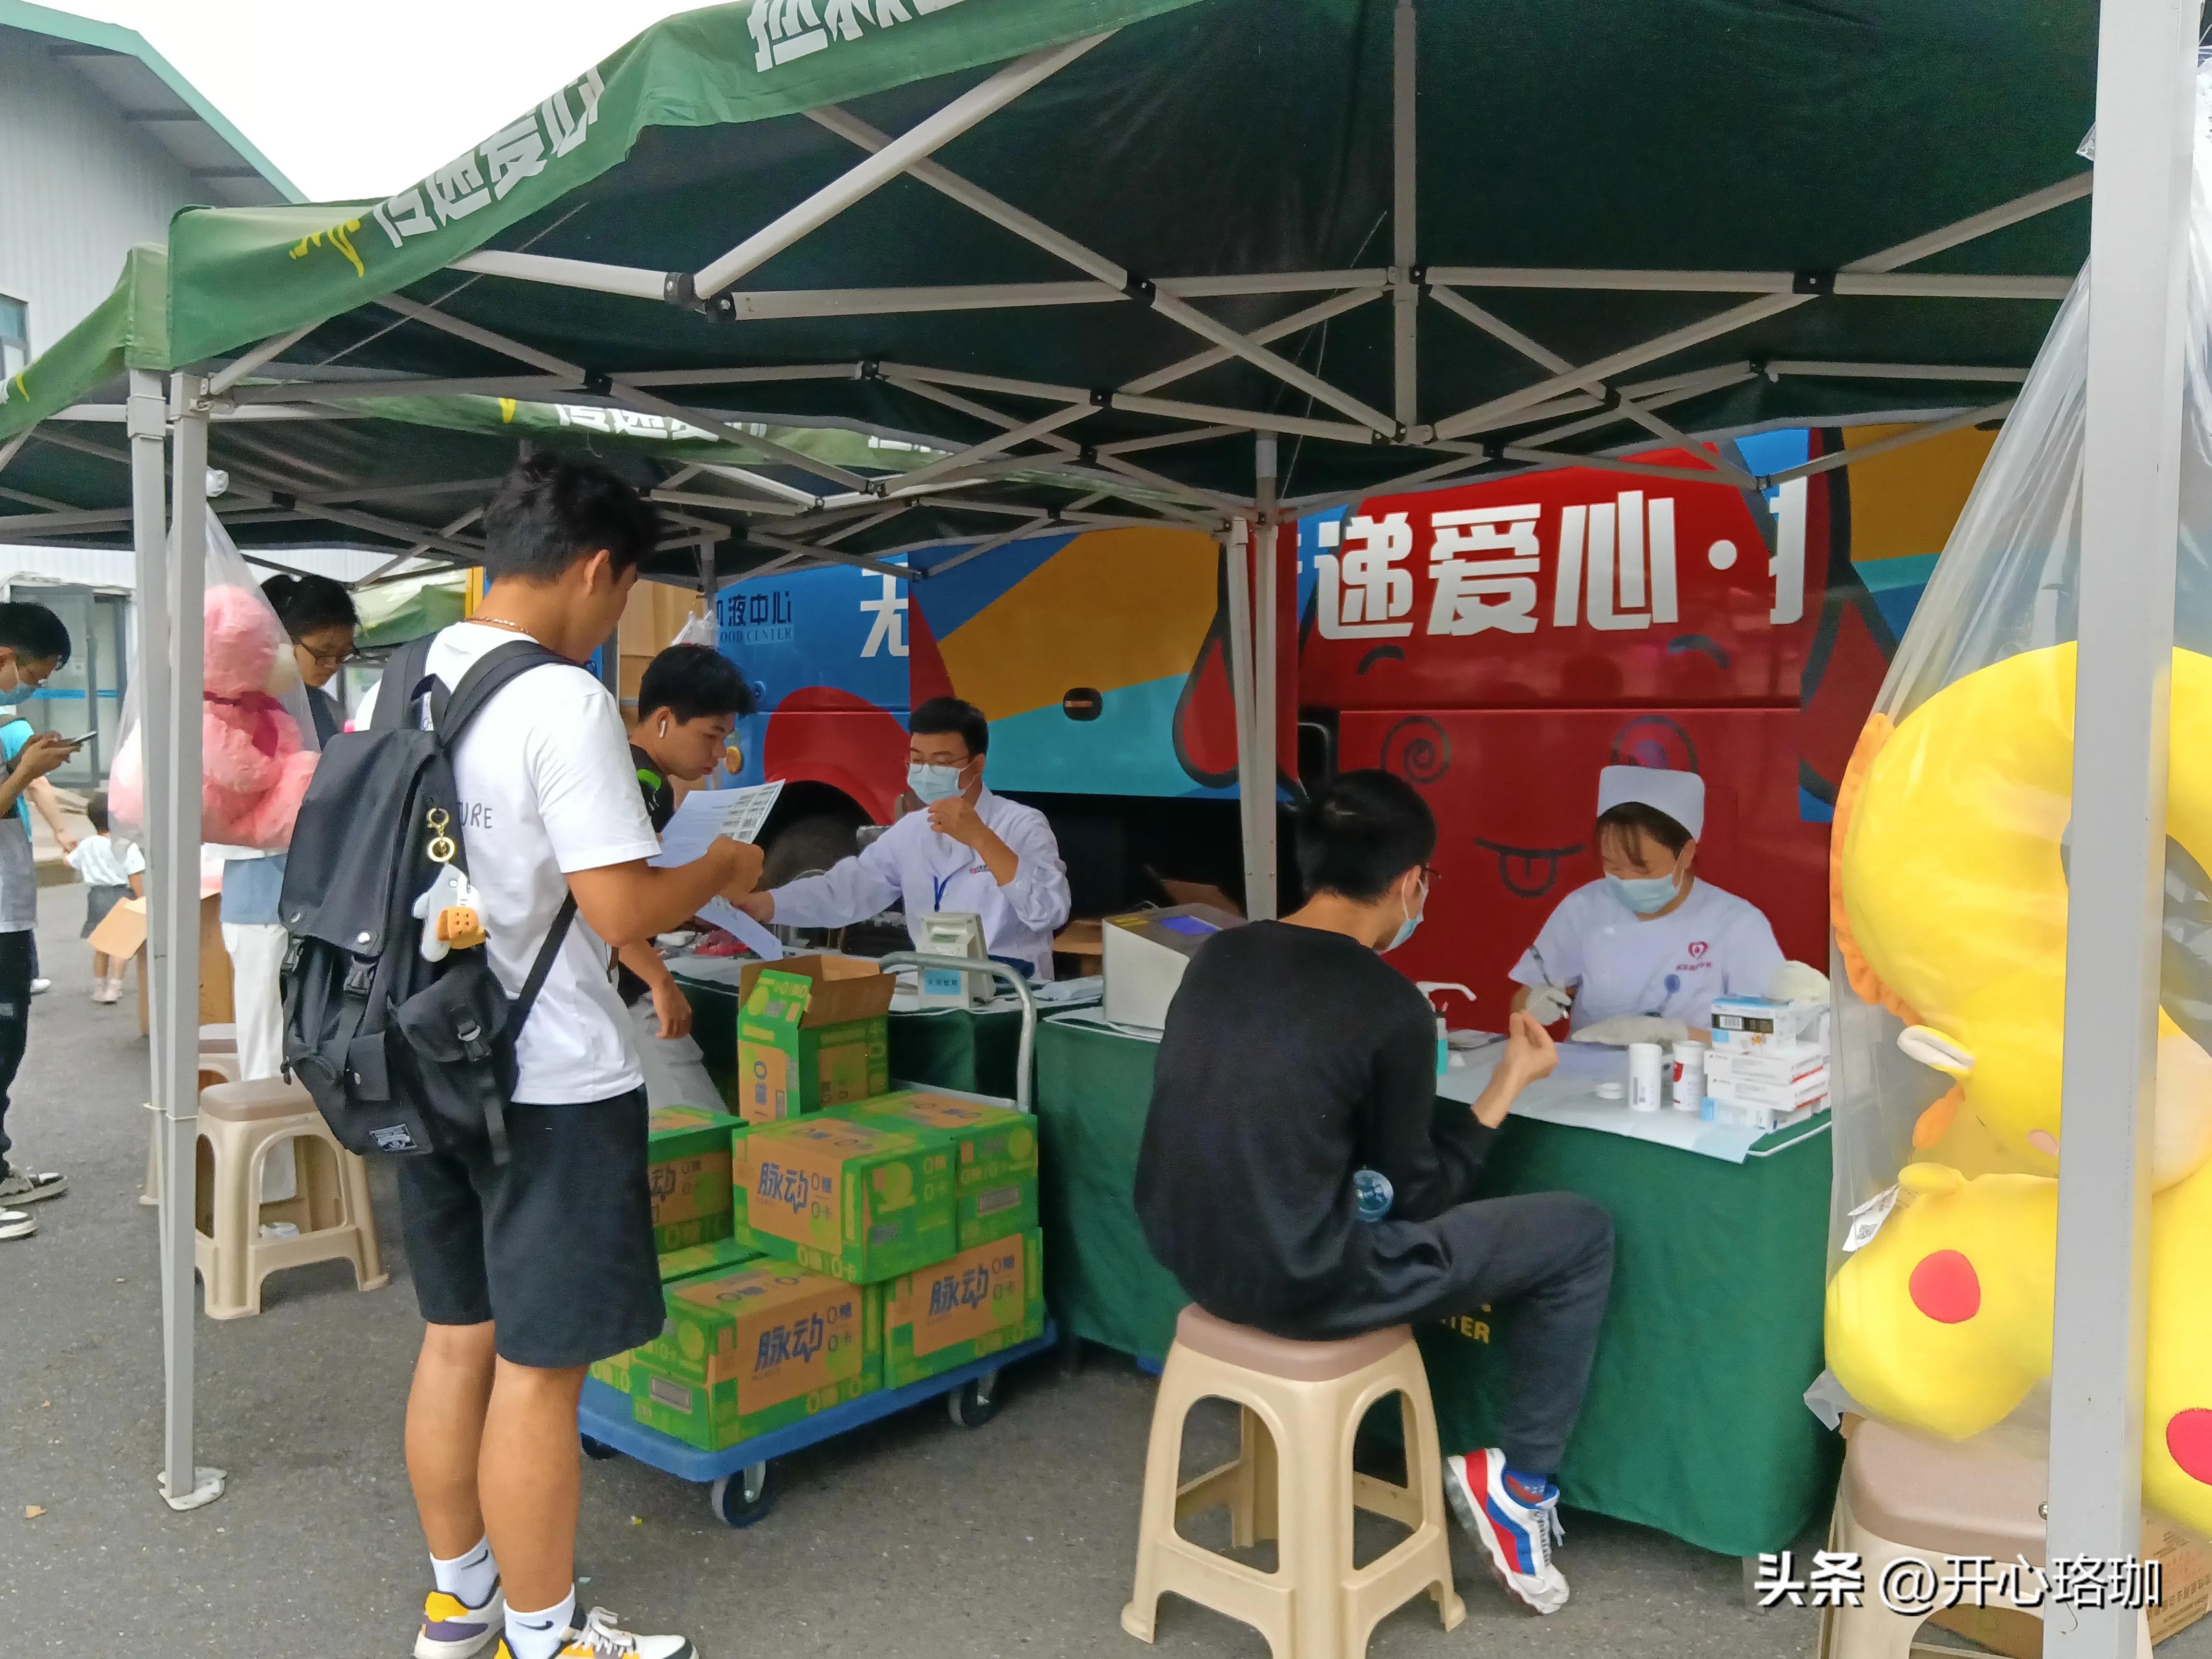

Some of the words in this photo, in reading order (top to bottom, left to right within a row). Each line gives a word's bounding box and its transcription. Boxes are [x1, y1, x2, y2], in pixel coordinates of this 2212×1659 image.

[758, 1161, 808, 1214] 脉动
[928, 1263, 989, 1316] 脉动
[754, 1312, 824, 1371] 脉动
